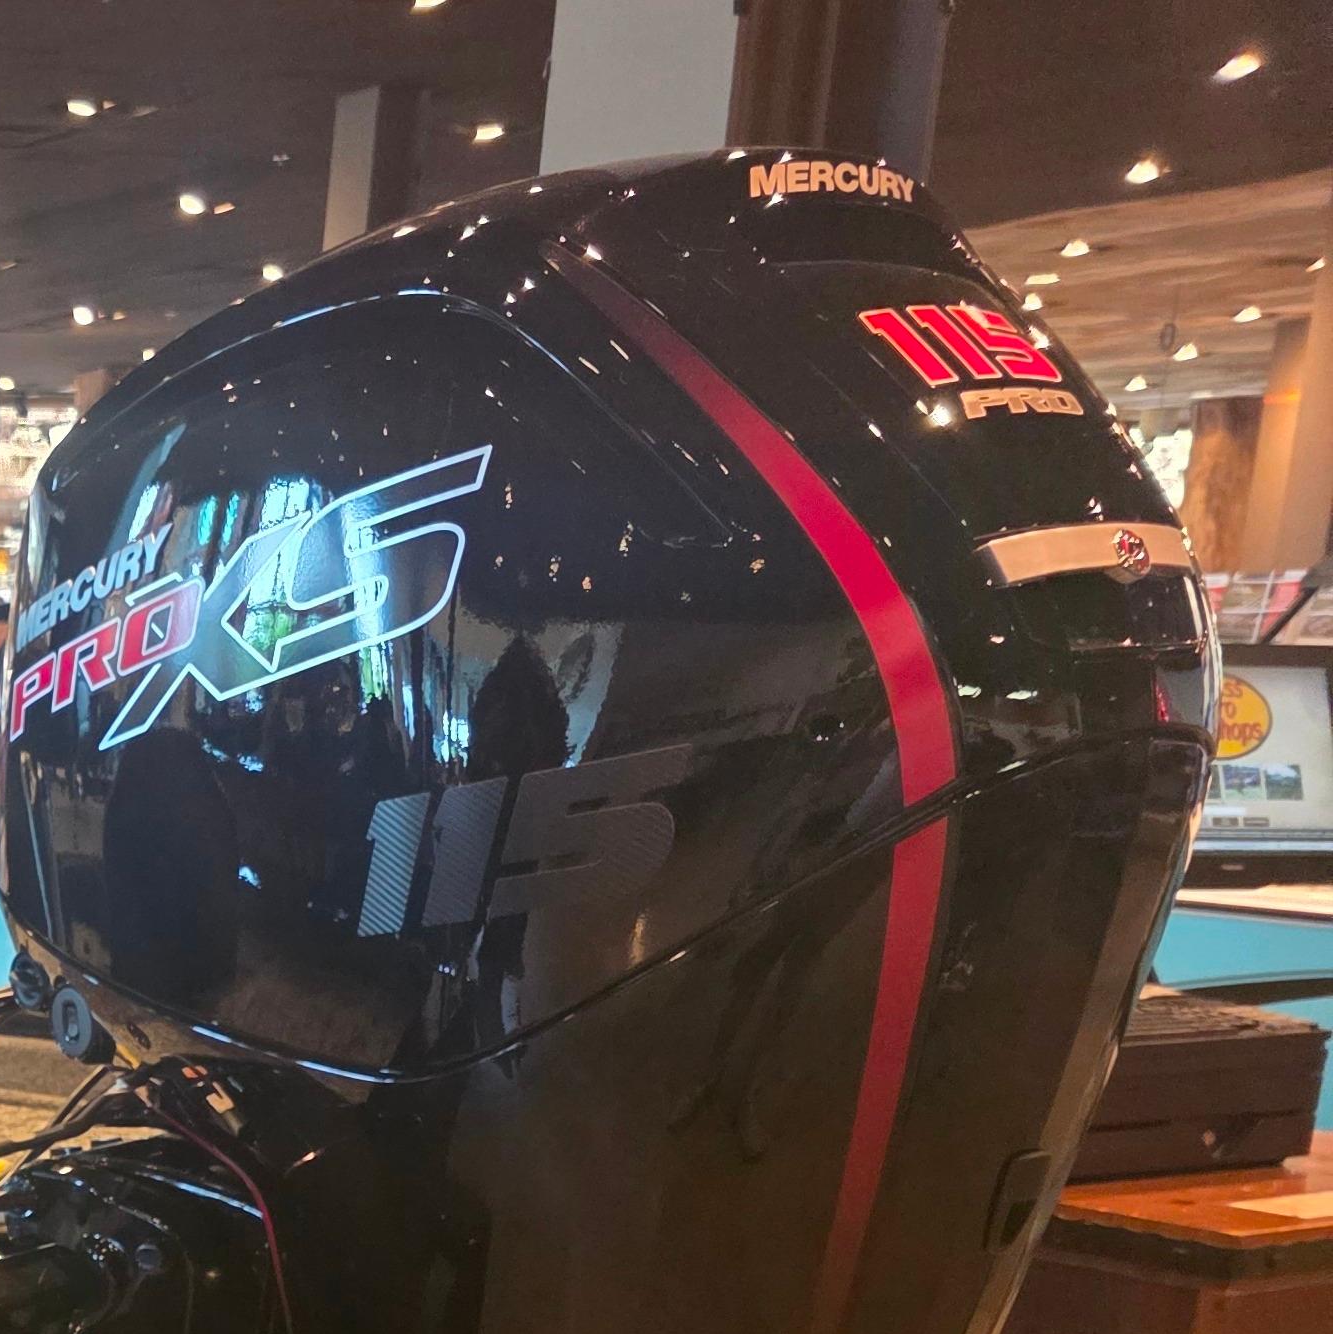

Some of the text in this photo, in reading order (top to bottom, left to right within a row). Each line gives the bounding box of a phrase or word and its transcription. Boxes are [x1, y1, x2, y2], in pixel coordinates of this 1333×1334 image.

[749, 161, 915, 203] MERCURY
[857, 303, 1063, 388] 115
[959, 387, 1085, 420] PRO
[16, 523, 173, 650] MERCURY
[9, 574, 207, 743] PRO
[1220, 722, 1262, 745] hops
